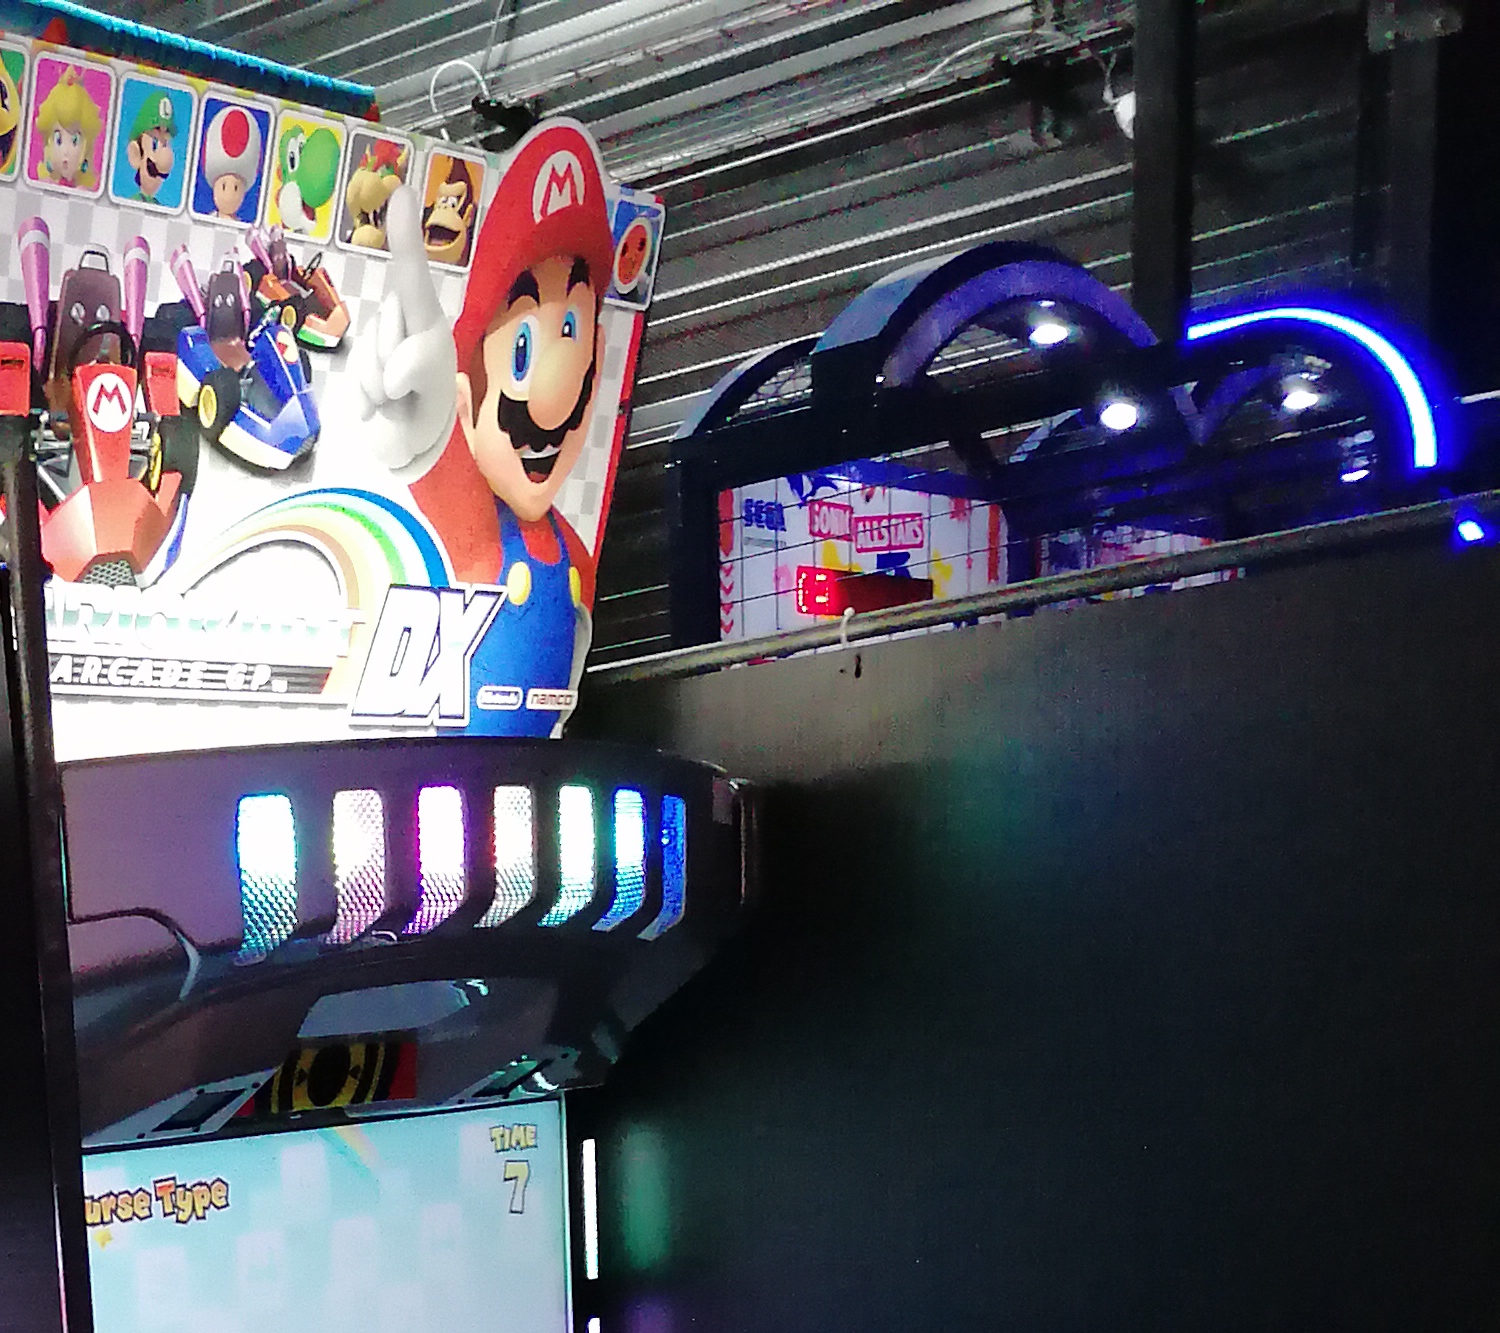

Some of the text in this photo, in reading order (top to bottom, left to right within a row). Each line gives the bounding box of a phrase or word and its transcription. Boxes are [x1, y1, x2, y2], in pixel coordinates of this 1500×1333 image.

[50, 654, 208, 689] ARCADE
[225, 662, 274, 691] GP
[350, 583, 504, 720] DX
[490, 1123, 538, 1154] TIME
[153, 1175, 231, 1225] Type
[502, 1159, 531, 1215] 7
